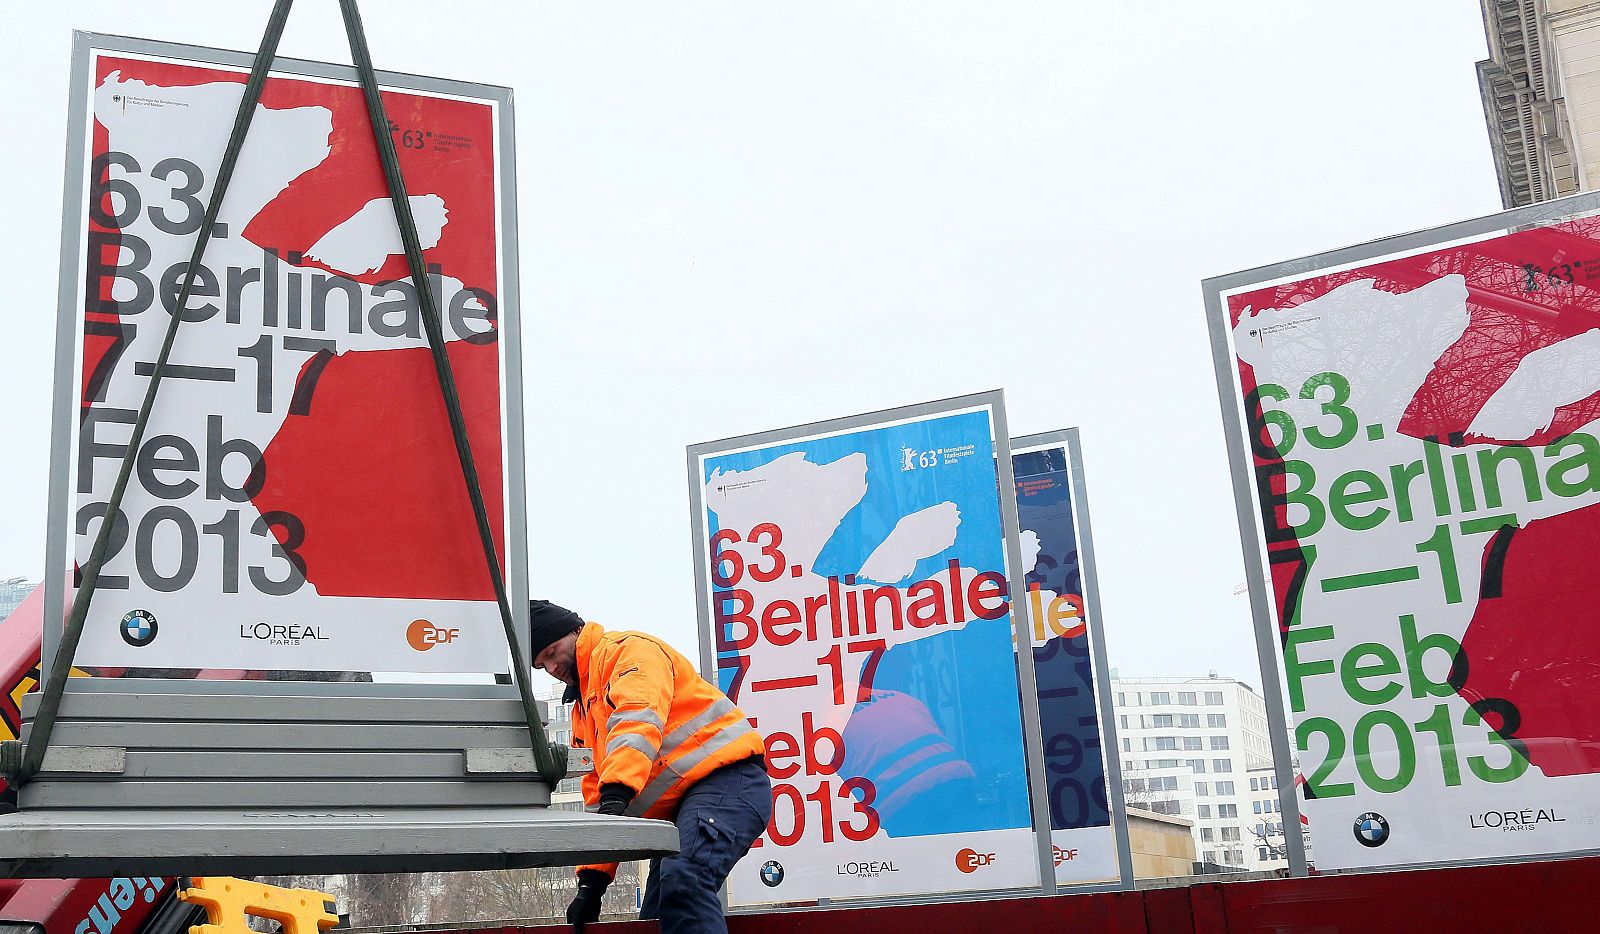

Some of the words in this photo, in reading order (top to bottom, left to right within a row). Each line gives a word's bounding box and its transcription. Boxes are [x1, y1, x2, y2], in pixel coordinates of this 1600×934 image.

[402, 129, 425, 149] 63
[90, 151, 229, 239] 63.
[87, 230, 499, 345] Berlinale
[78, 406, 267, 503] Feb
[919, 450, 938, 468] 63
[1245, 371, 1385, 461] 63.
[73, 501, 308, 597] 2013
[709, 522, 803, 588] 63.
[269, 638, 301, 646] PARIS
[711, 558, 1010, 652] Berlinale
[1282, 613, 1470, 713] Feb
[1294, 697, 1532, 800] 2013
[749, 775, 881, 849] 013
[1502, 824, 1535, 832] PARIS
